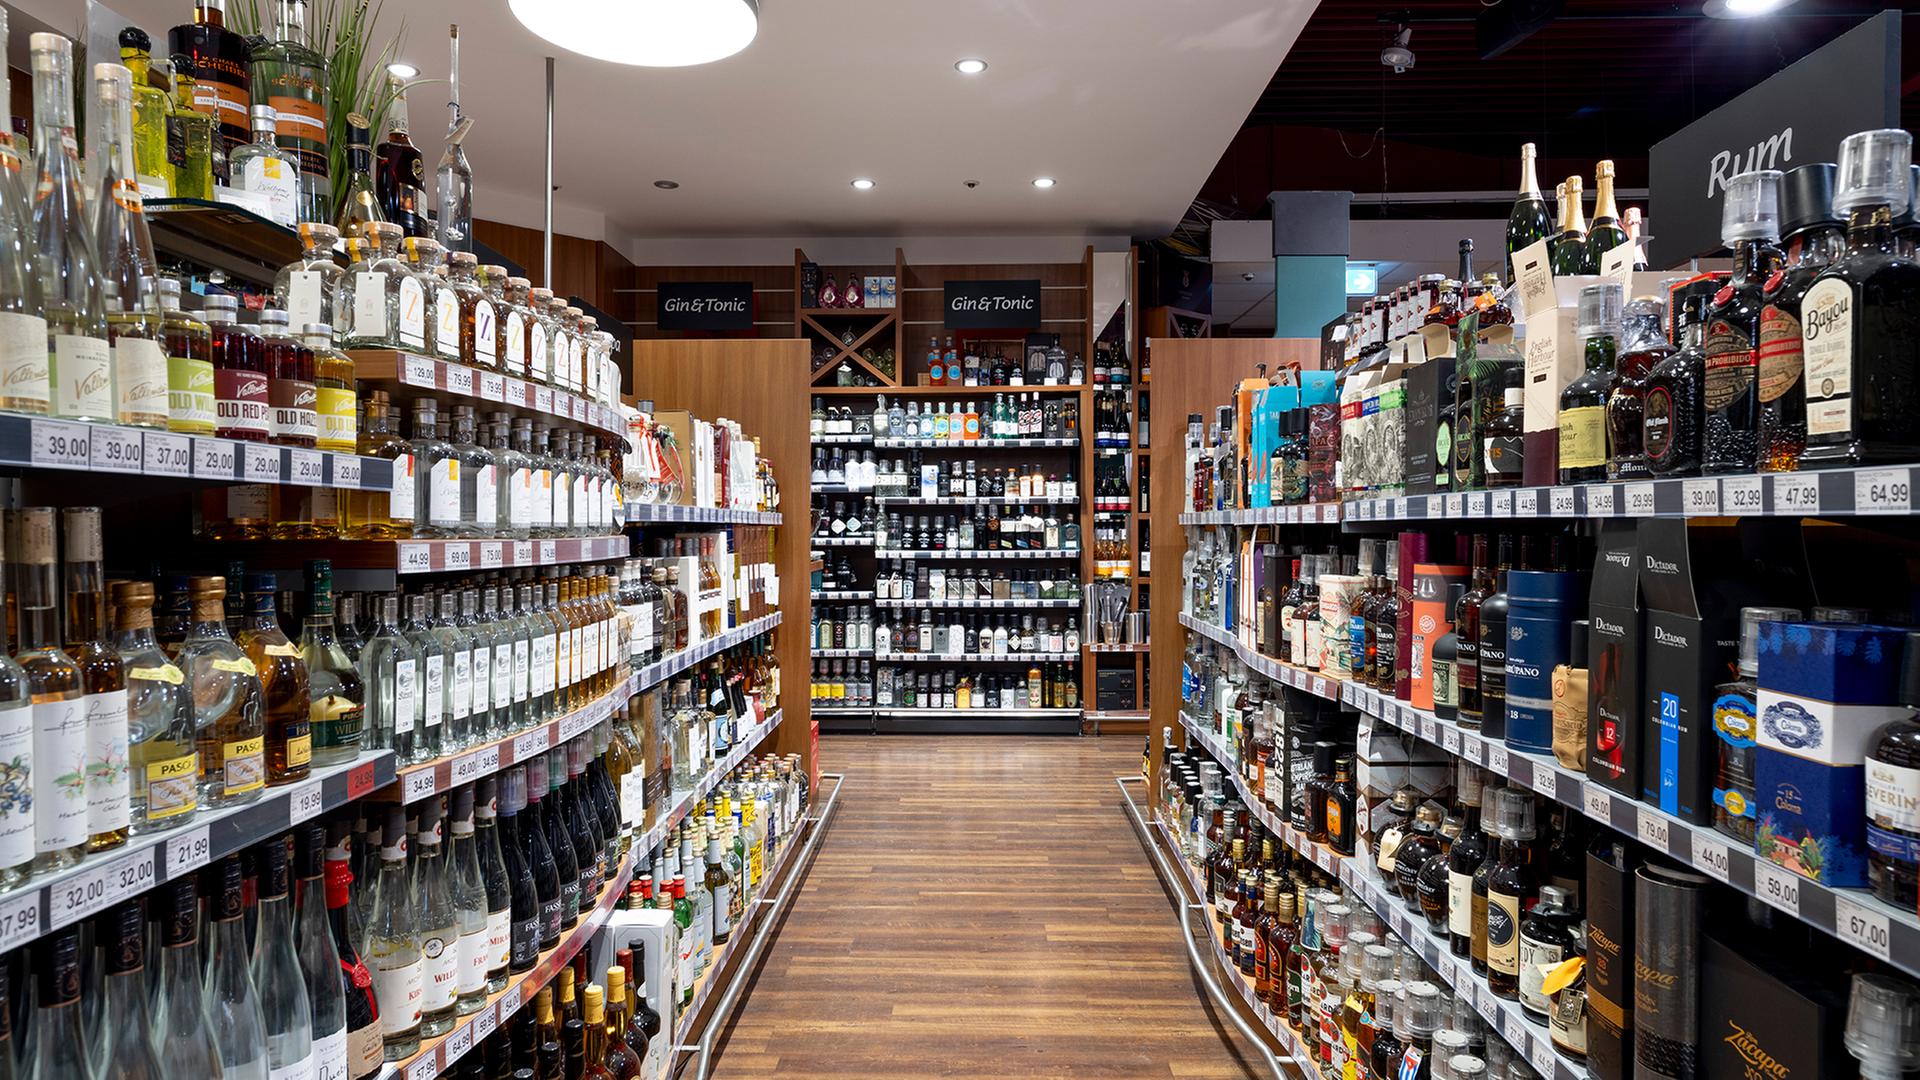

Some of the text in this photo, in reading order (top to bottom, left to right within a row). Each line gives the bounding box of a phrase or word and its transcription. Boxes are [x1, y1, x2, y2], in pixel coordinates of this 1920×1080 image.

[1707, 127, 1793, 199] Rum
[664, 298, 746, 313] Gin&Tonic
[951, 296, 1034, 312] Gin&Tonic
[1805, 297, 1848, 341] Bayou
[453, 373, 472, 388] 79,99
[217, 402, 239, 418] OLD
[242, 404, 260, 419] RED
[276, 409, 297, 425] OLD
[49, 436, 88, 458] 39,00
[106, 441, 140, 463] 39,00
[156, 447, 188, 468] 37,00
[206, 452, 233, 472] 29,00
[255, 457, 279, 474] 29,00
[299, 461, 322, 478] 29,00
[340, 465, 361, 481] 29,00
[1620, 462, 1648, 475] Mon
[1594, 495, 1612, 509] 34,99
[1632, 494, 1653, 510] 29,99
[1691, 490, 1717, 507] 39,00
[1733, 490, 1761, 507] 32,99
[1786, 488, 1818, 505] 47,99
[1871, 484, 1909, 505] 64,99
[408, 553, 429, 567] 44,99
[451, 549, 469, 564] 69,00
[1456, 642, 1476, 652] PANO
[1662, 697, 1678, 718] 20
[1606, 727, 1614, 739] 12
[457, 761, 476, 777] 49,00
[482, 754, 499, 769] 34,99
[354, 770, 373, 789] 24,99
[413, 775, 434, 793] 34,99
[300, 791, 321, 812] 19,99
[1785, 789, 1794, 800] 15
[1866, 785, 1917, 811] EVERIN
[1590, 797, 1609, 816] 49,00
[1775, 796, 1803, 816] Coloma
[1645, 820, 1668, 844] 79,00
[178, 836, 208, 865] 21,99
[1702, 843, 1728, 873] 44,00
[119, 860, 153, 889] 32,00
[66, 879, 104, 910] 32,00
[1767, 877, 1798, 905] 59,00
[1589, 923, 1621, 957] Zacapa
[1850, 916, 1887, 948] 67,00
[453, 1033, 470, 1054] 64,99
[1724, 1019, 1791, 1079] Zacapa
[416, 1058, 436, 1080] 57,99
